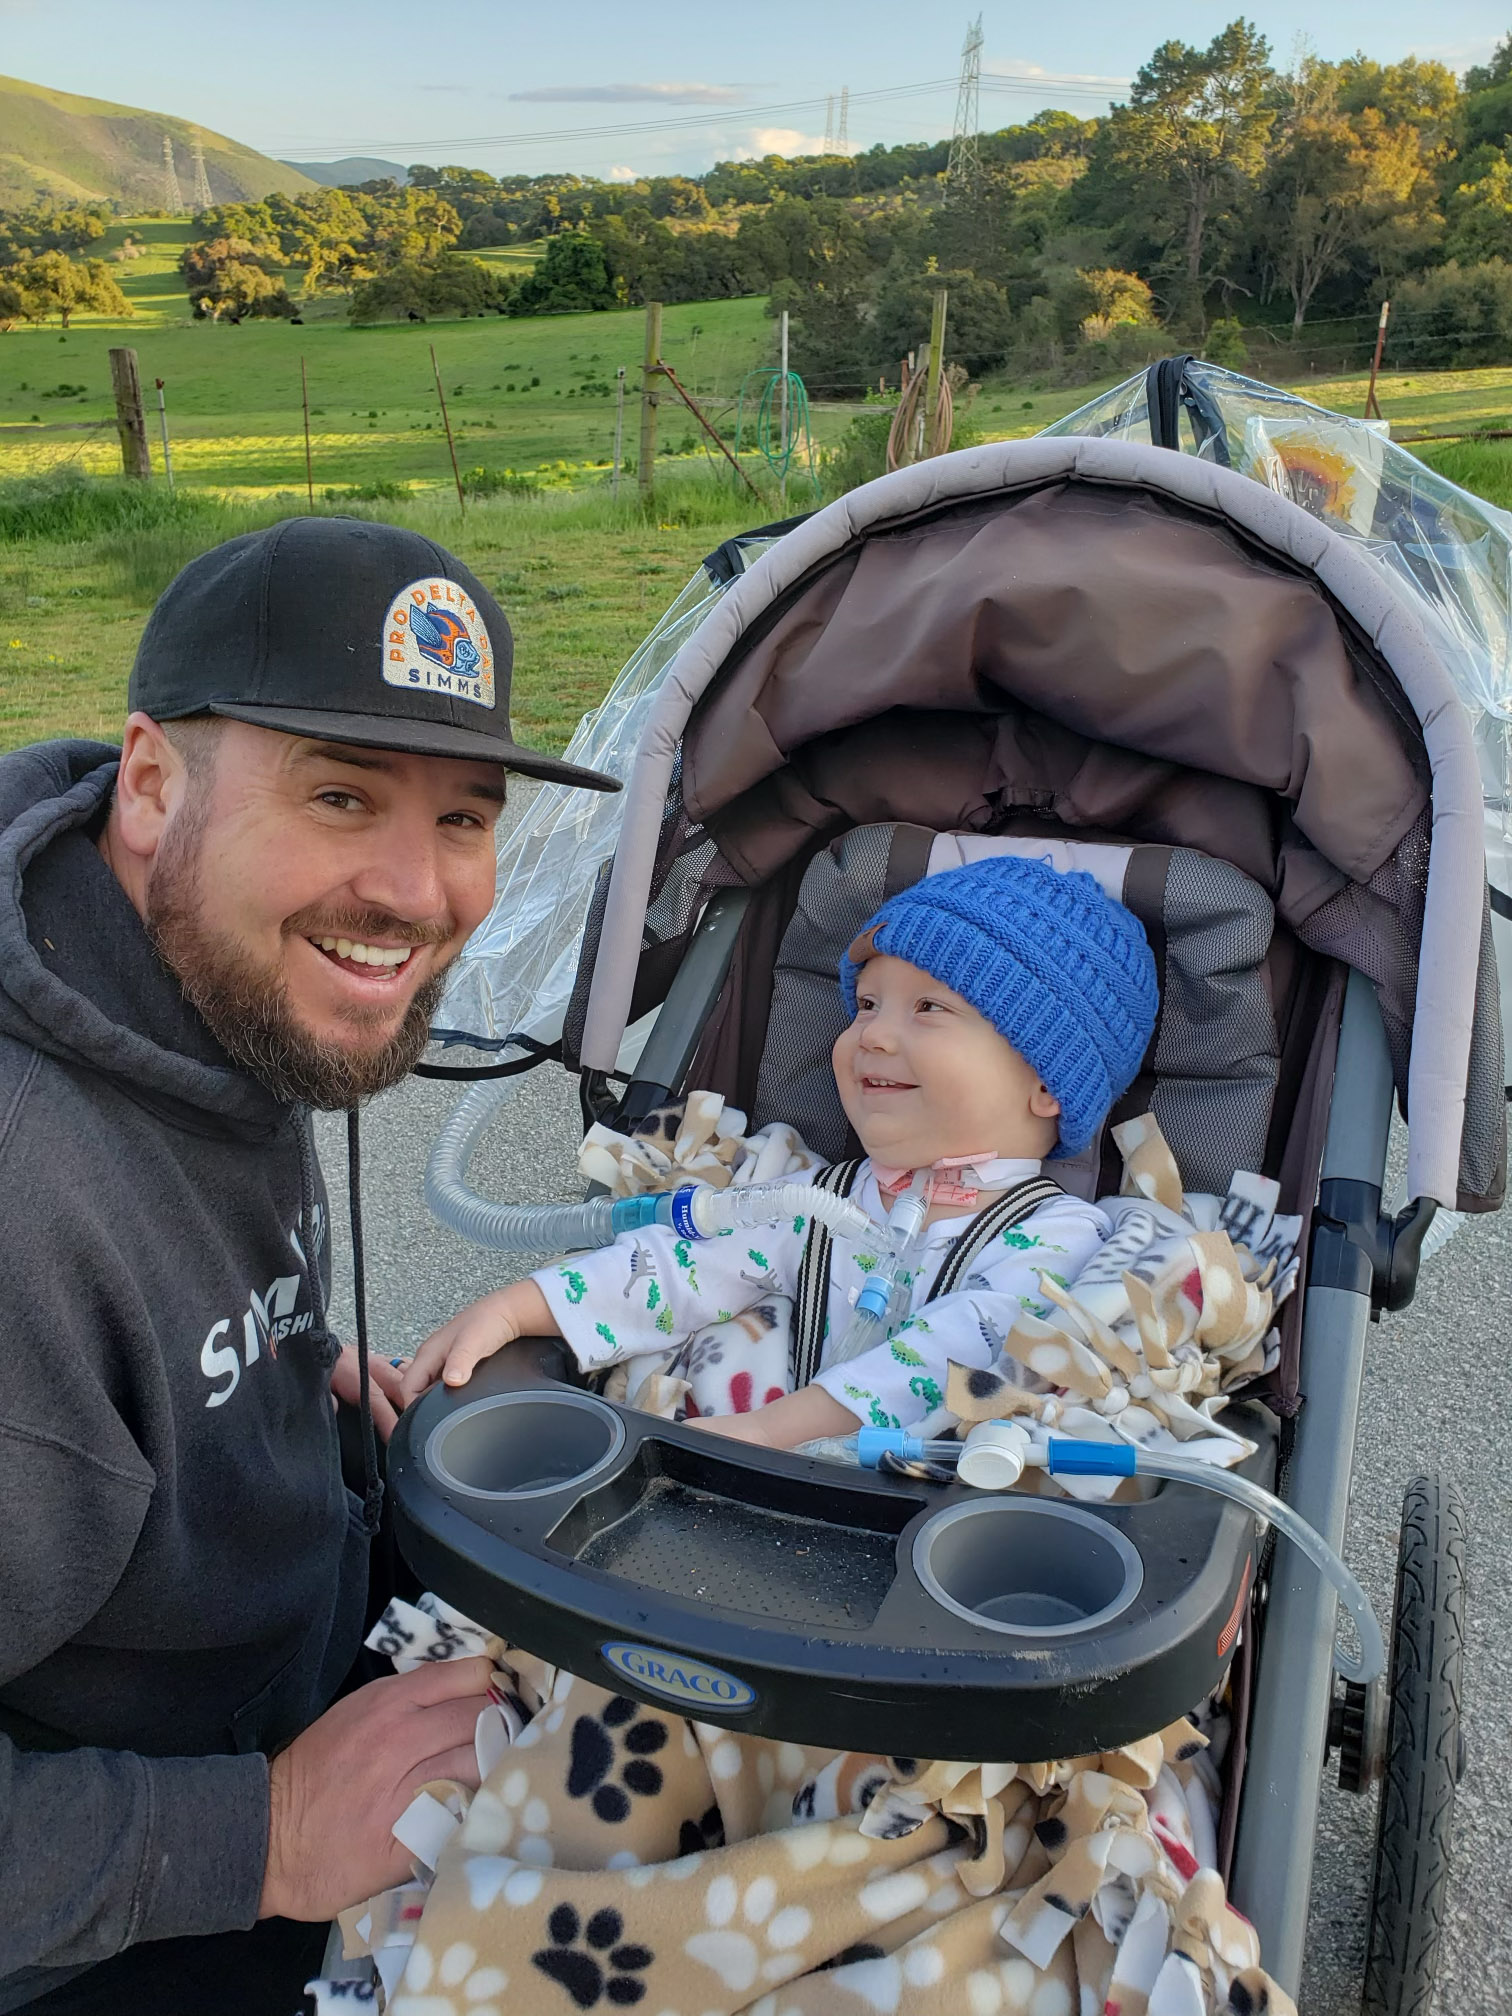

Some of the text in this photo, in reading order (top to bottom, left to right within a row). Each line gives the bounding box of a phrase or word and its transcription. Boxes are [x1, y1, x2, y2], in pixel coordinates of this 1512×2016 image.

[389, 608, 409, 663] PRO
[411, 584, 475, 624] DELTA
[408, 668, 482, 699] SIMMS
[621, 1651, 738, 1700] GRACO
